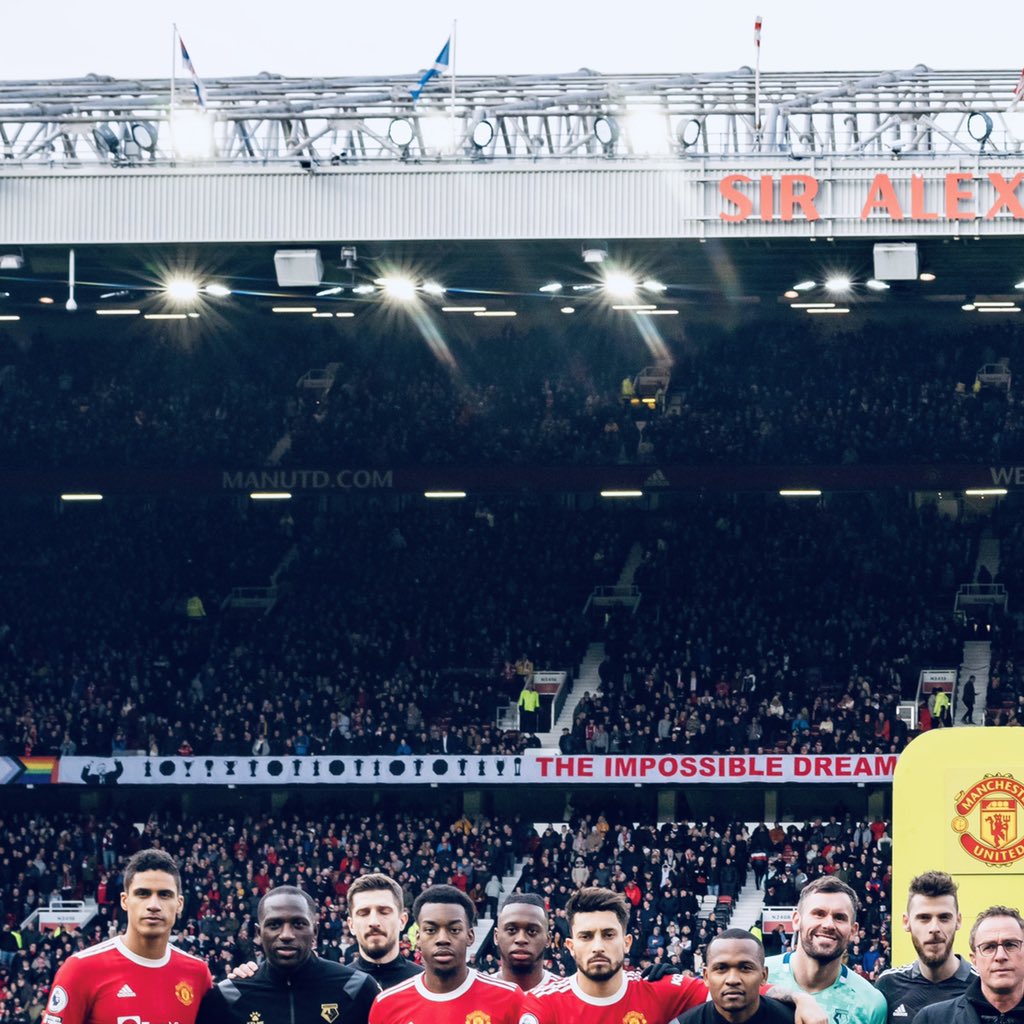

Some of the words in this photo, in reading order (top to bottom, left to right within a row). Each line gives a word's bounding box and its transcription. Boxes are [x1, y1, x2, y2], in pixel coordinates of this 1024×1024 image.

[719, 174, 820, 222] SIR
[222, 470, 393, 488] MANUTD.COM
[536, 757, 594, 777] THE
[605, 756, 783, 777] IMPOSSIBLE
[794, 756, 897, 778] DREAM
